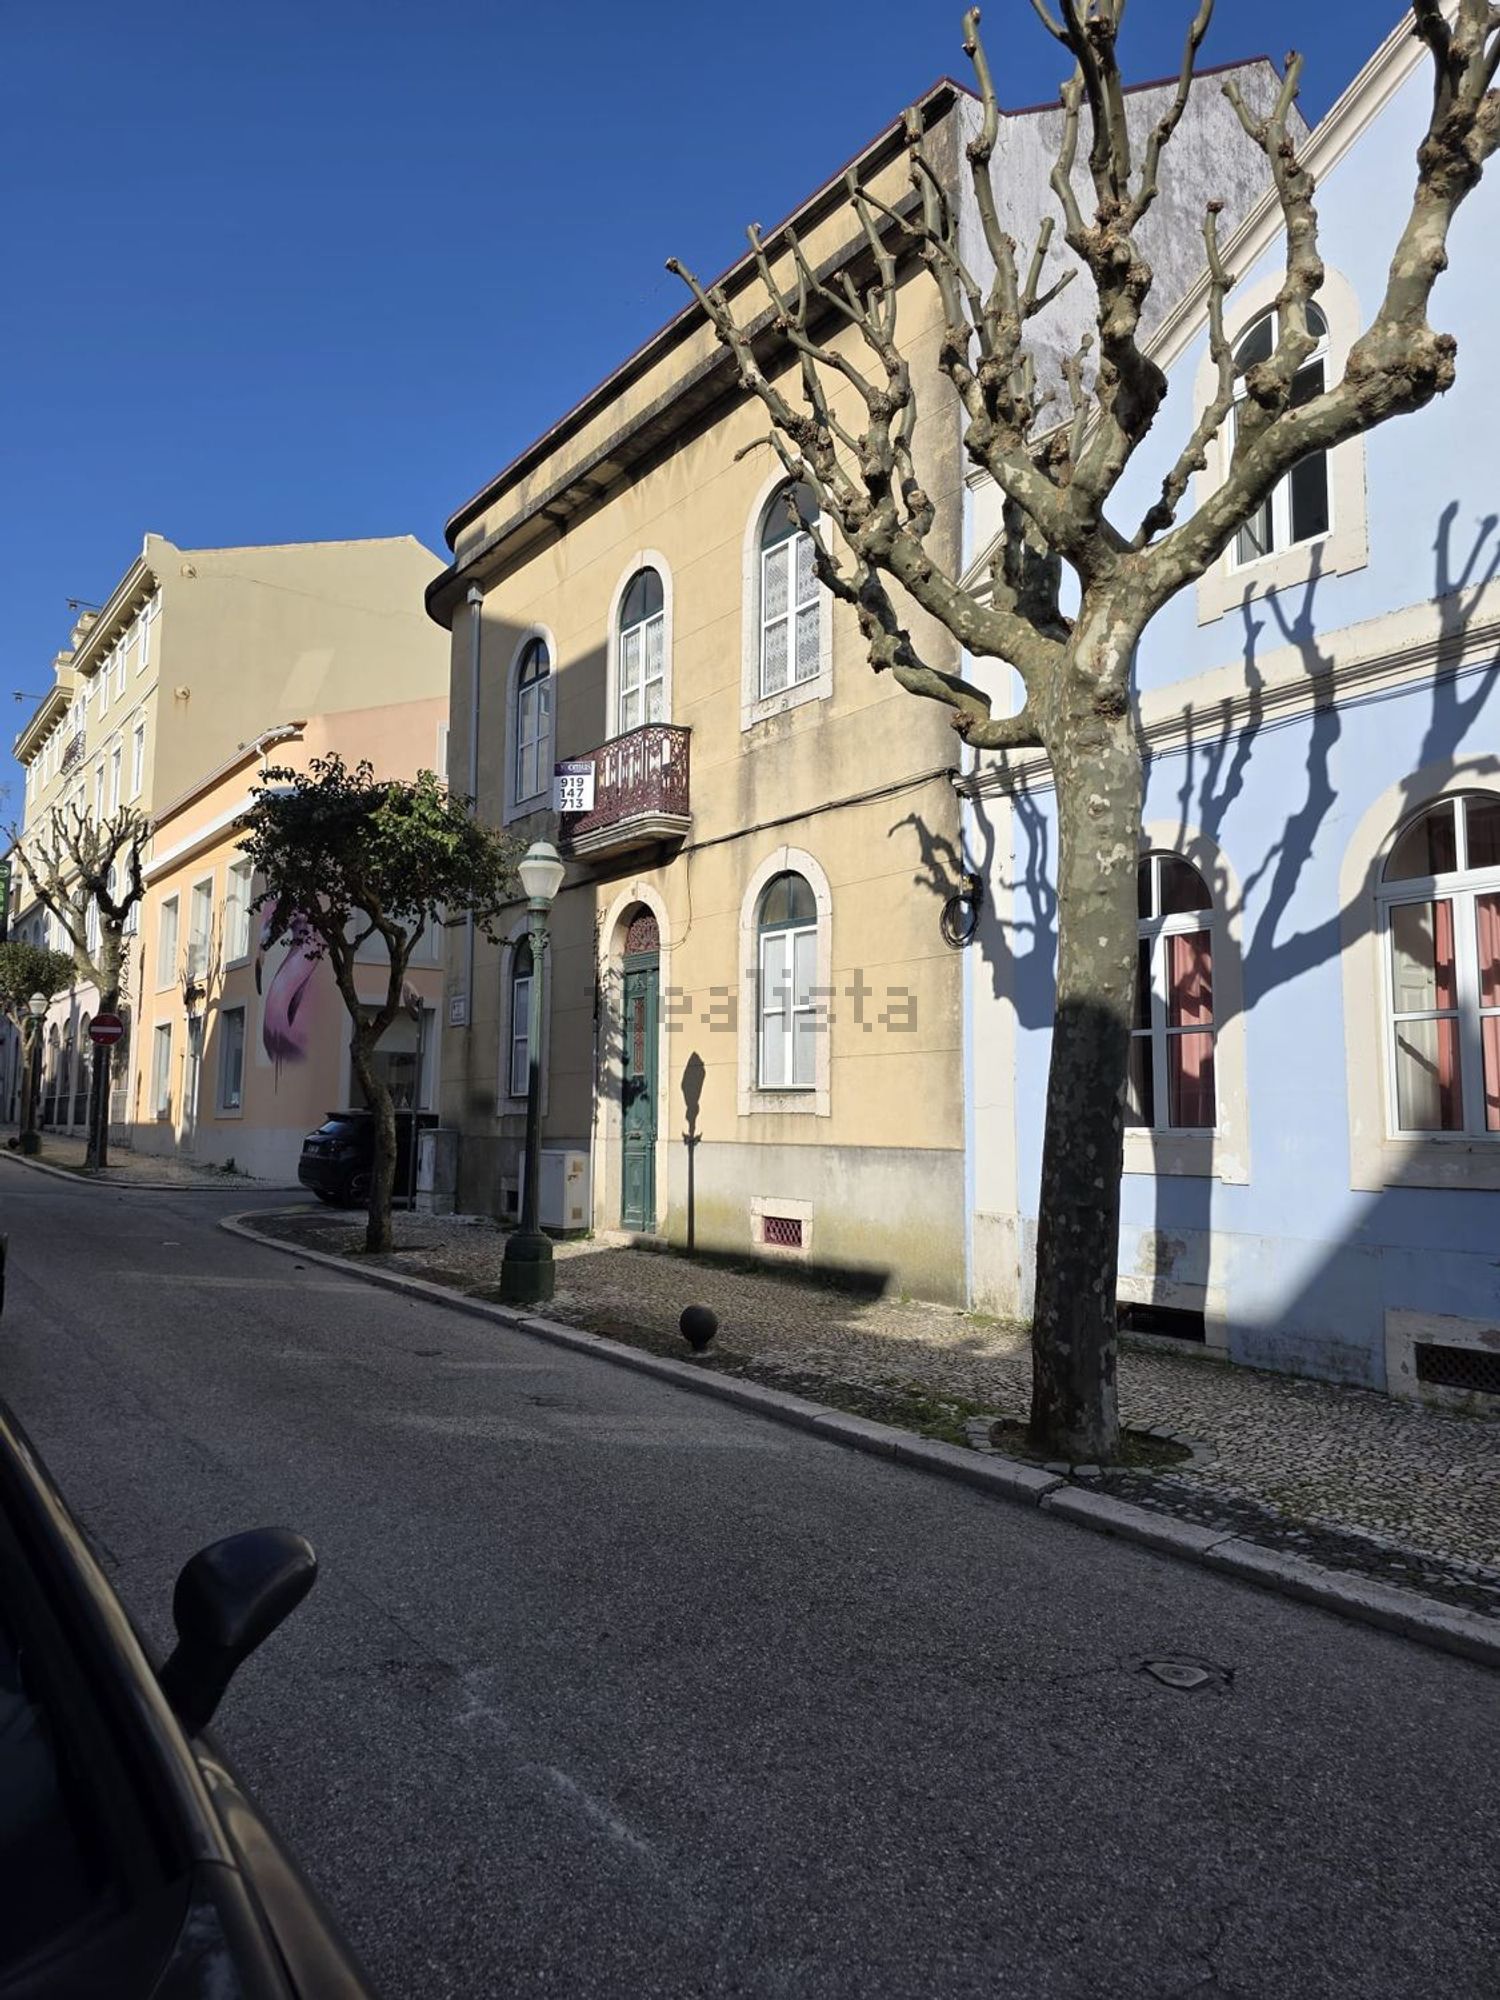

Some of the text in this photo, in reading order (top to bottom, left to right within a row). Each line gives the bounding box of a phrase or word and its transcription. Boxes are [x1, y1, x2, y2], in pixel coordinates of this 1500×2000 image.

[561, 777, 584, 787] 919
[560, 788, 584, 798] 147
[560, 799, 583, 808] 713
